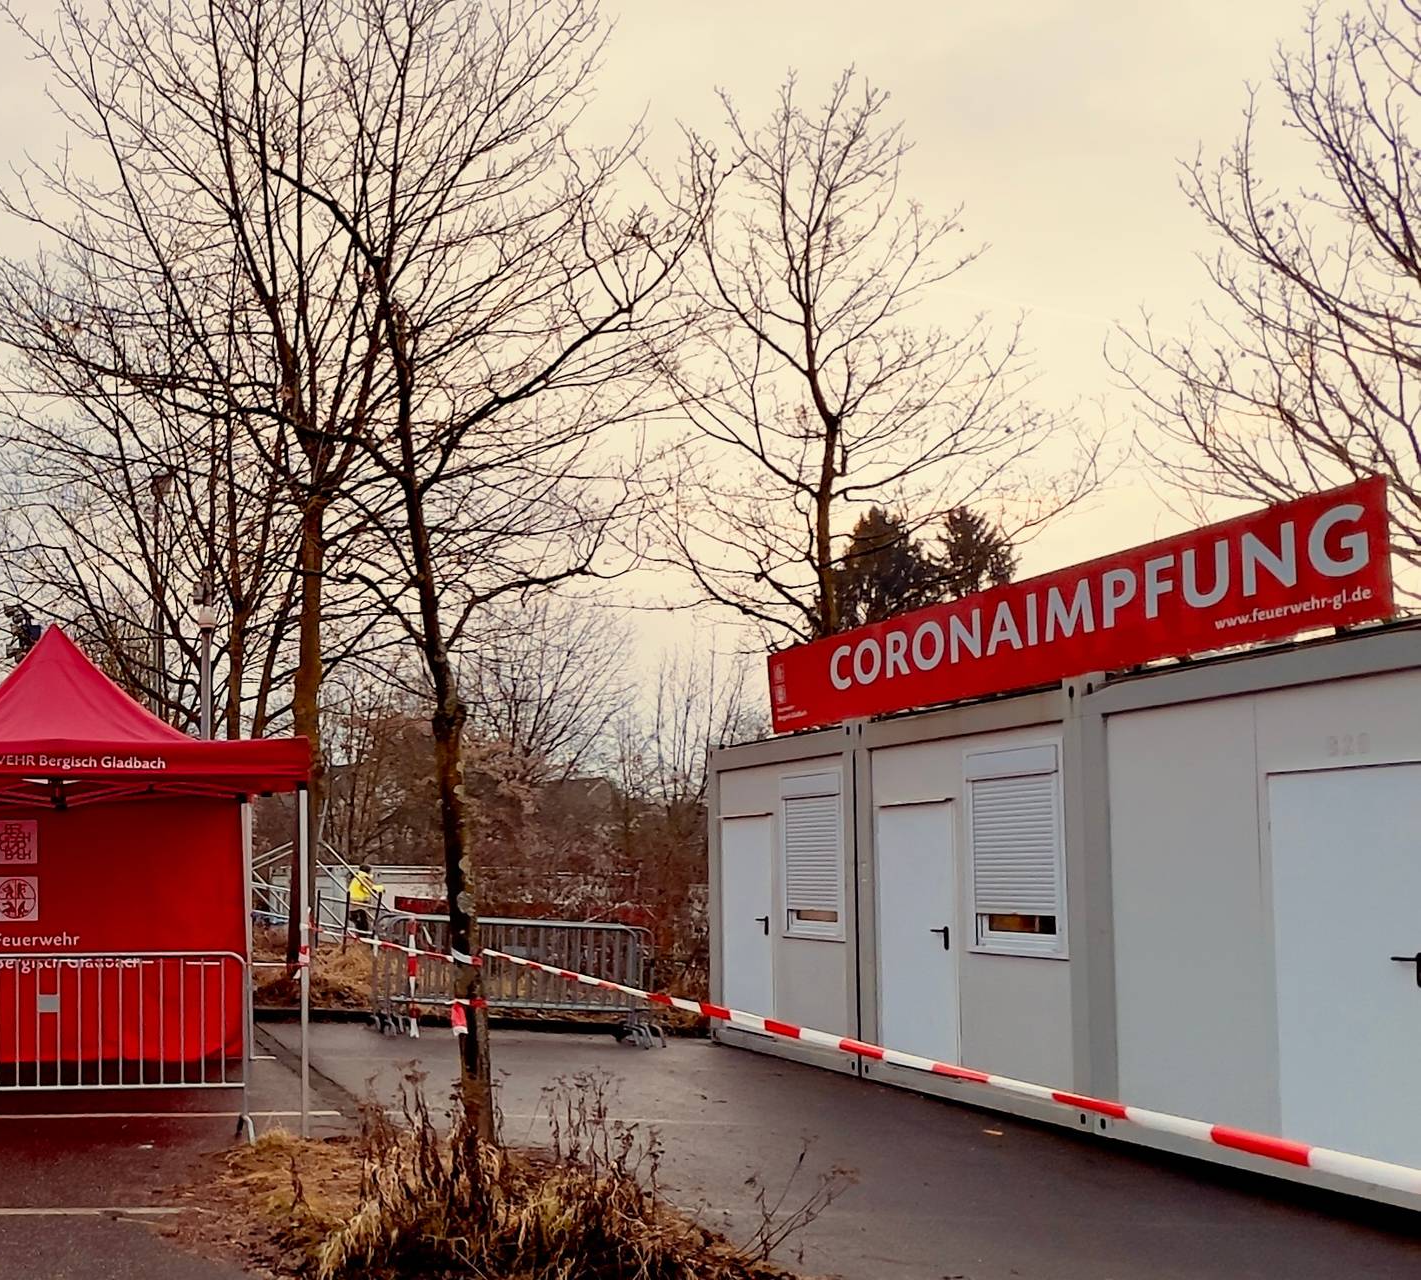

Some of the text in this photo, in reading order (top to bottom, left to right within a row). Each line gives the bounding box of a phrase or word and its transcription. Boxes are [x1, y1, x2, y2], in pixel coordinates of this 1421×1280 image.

[829, 503, 1370, 691] CORONAIMPFUNG
[1214, 586, 1373, 630] www.feuerwehr-gl.de
[39, 755, 97, 770] Bergisch
[101, 756, 166, 770] Gladbach
